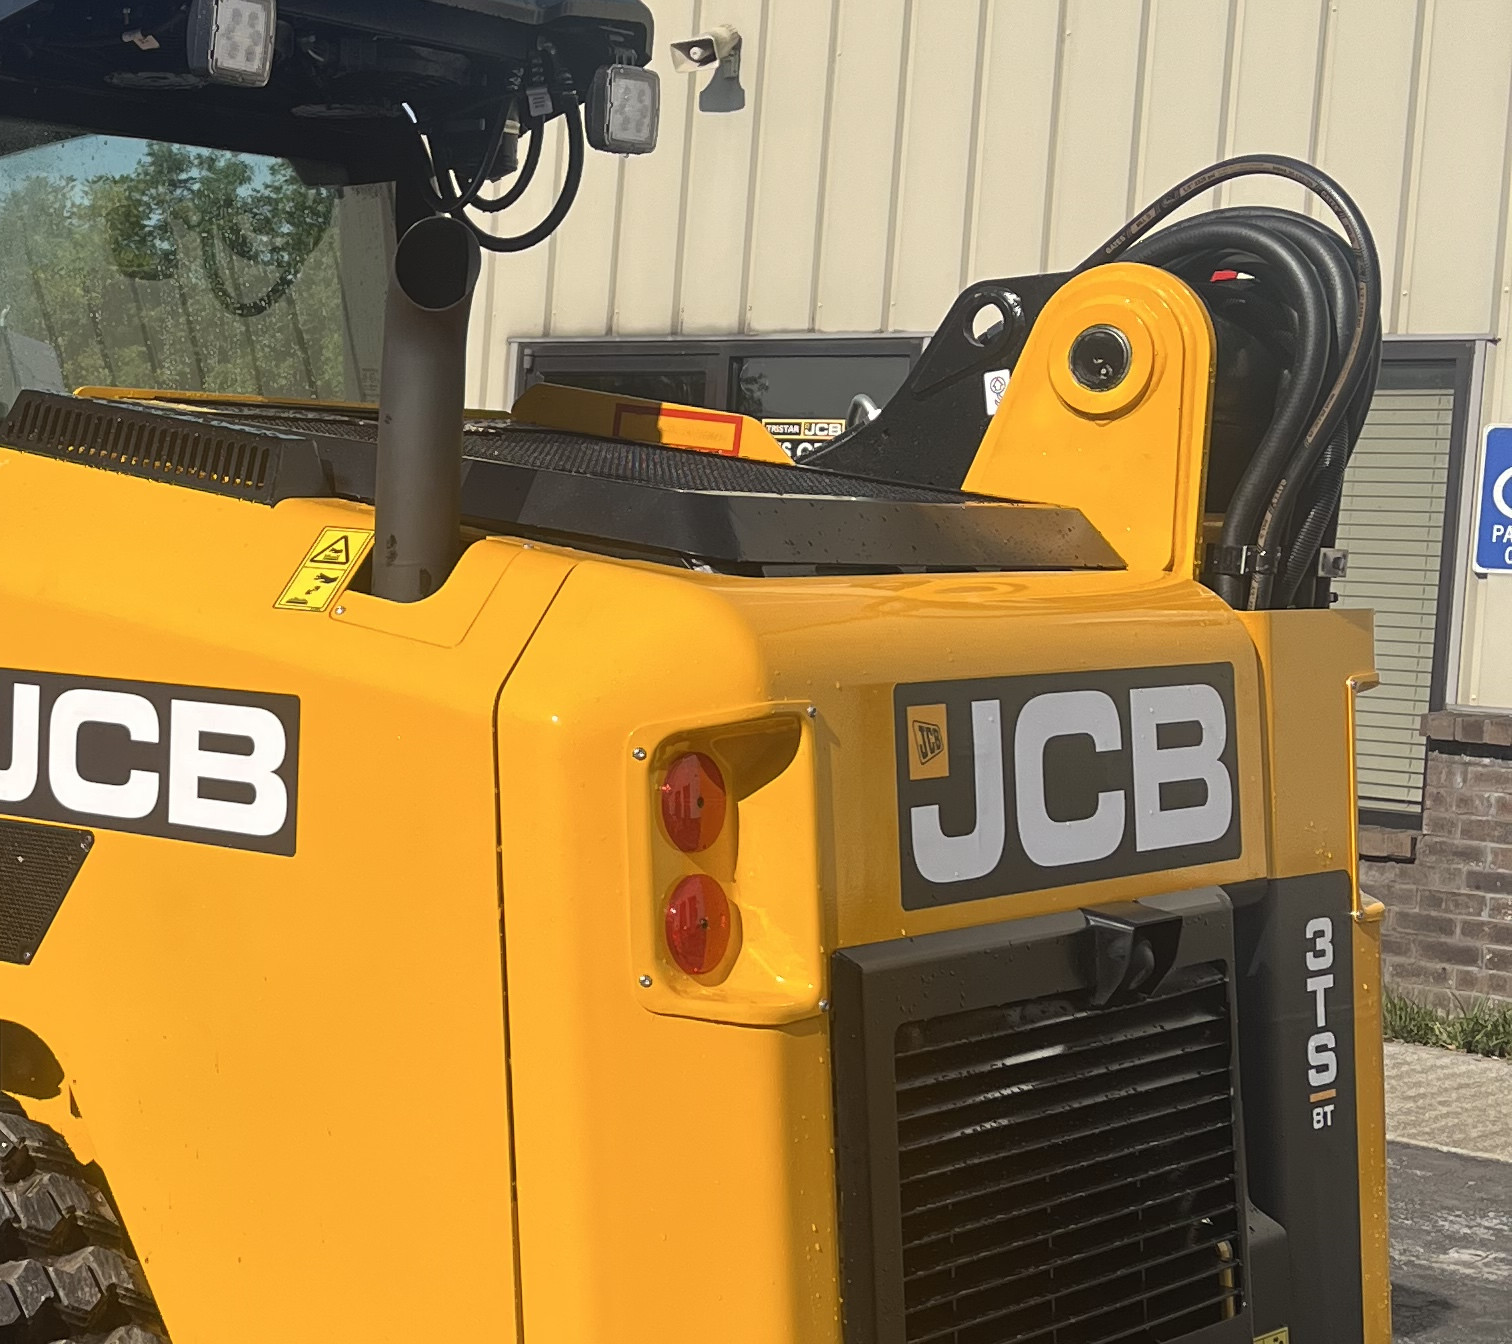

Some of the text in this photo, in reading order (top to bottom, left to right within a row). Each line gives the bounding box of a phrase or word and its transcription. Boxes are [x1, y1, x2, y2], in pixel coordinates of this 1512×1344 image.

[765, 424, 800, 434] TRISTAR
[804, 423, 842, 436] JCB
[918, 725, 942, 759] JCB
[910, 683, 1233, 884] JCB
[1305, 917, 1337, 1087] 3TS
[1312, 1104, 1335, 1130] 8T
